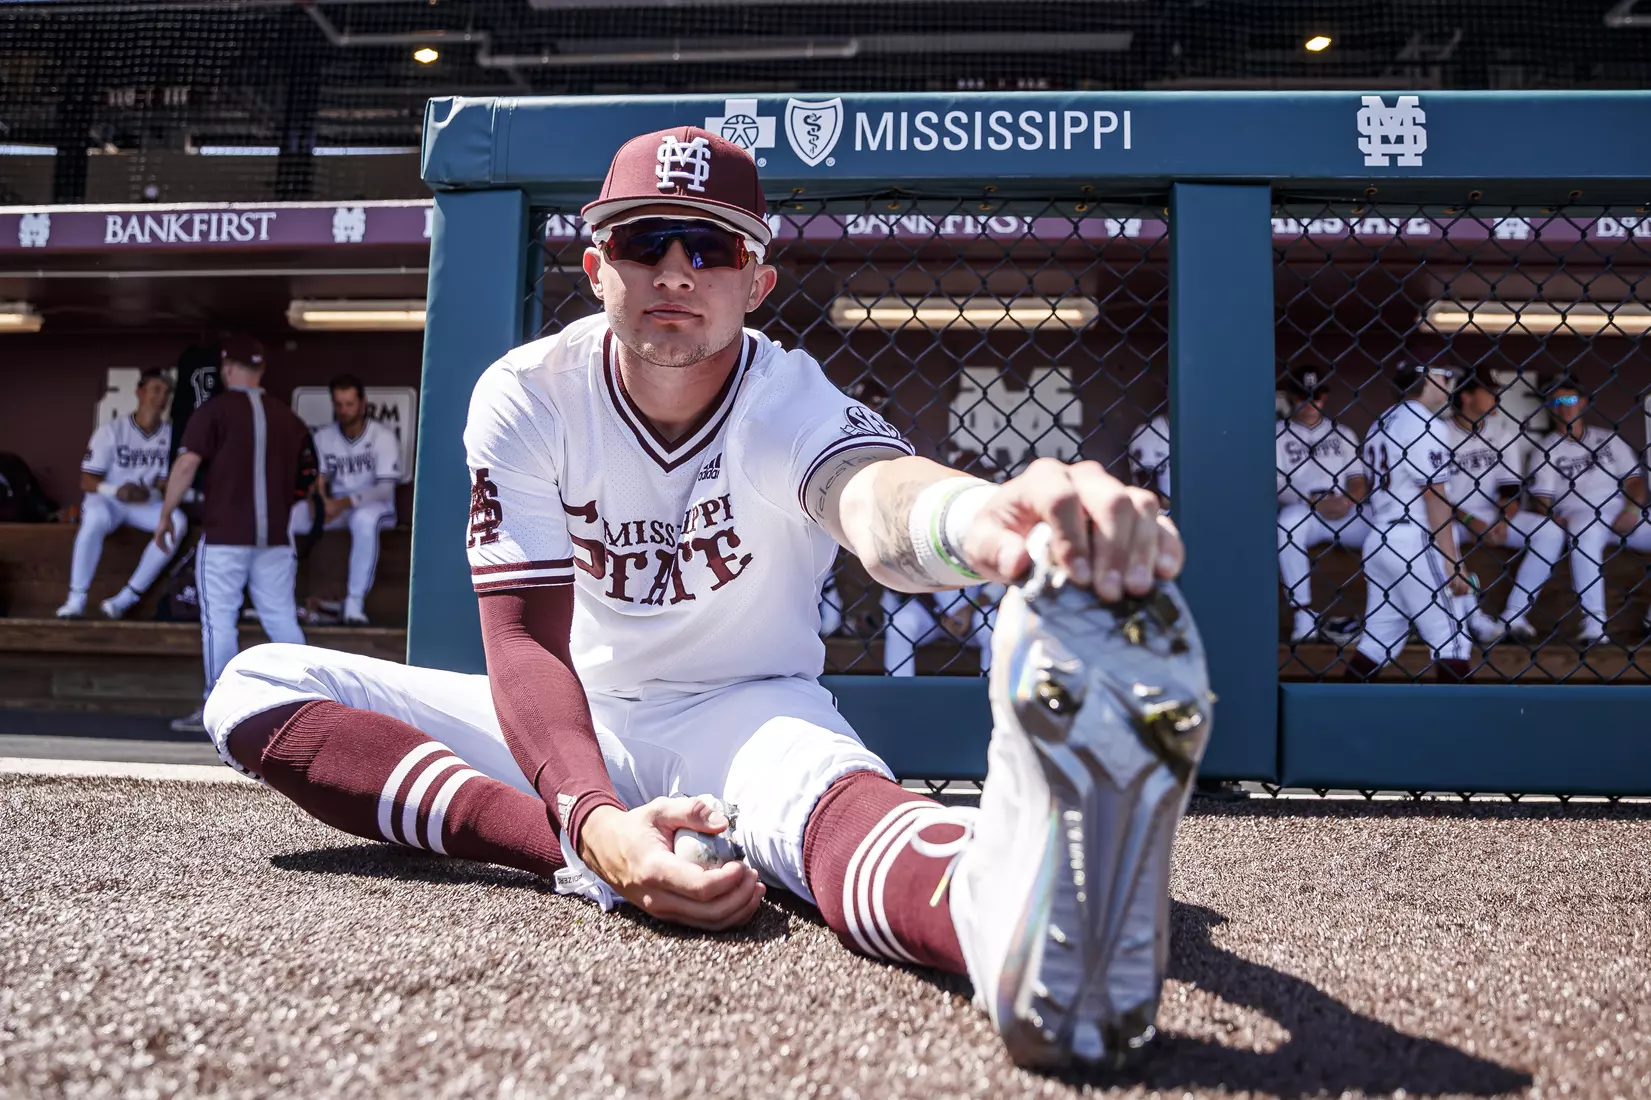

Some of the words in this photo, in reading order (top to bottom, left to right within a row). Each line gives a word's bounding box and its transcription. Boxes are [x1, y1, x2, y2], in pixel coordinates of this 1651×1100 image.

[855, 110, 1131, 151] MISSISSIPPI
[104, 211, 277, 245] BANKFIRST
[562, 499, 754, 606] STATE
